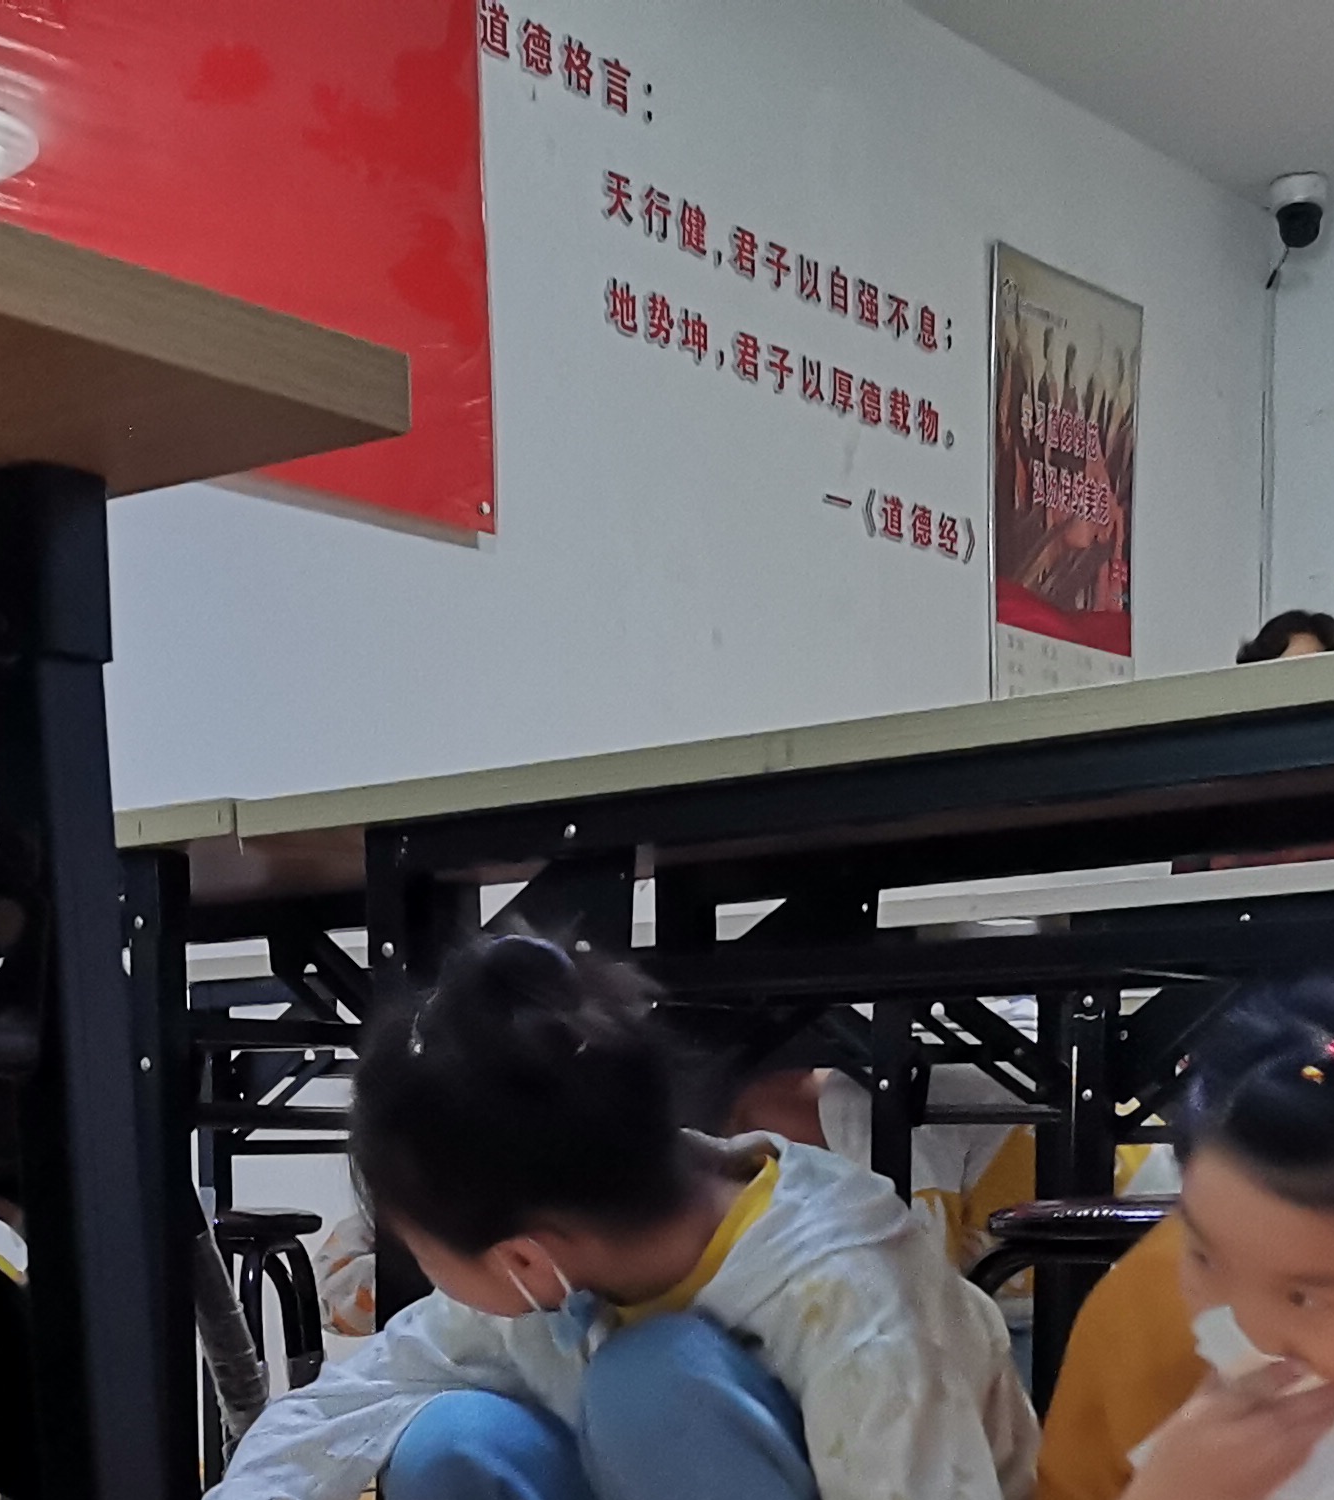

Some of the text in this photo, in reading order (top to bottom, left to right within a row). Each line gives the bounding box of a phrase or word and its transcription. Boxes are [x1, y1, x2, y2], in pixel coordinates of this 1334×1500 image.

[480, 1, 653, 122] 道德格言：
[607, 170, 952, 351] 天行健，君子以自强不息；
[609, 277, 954, 448] 地势坤，君子以厚德载物。
